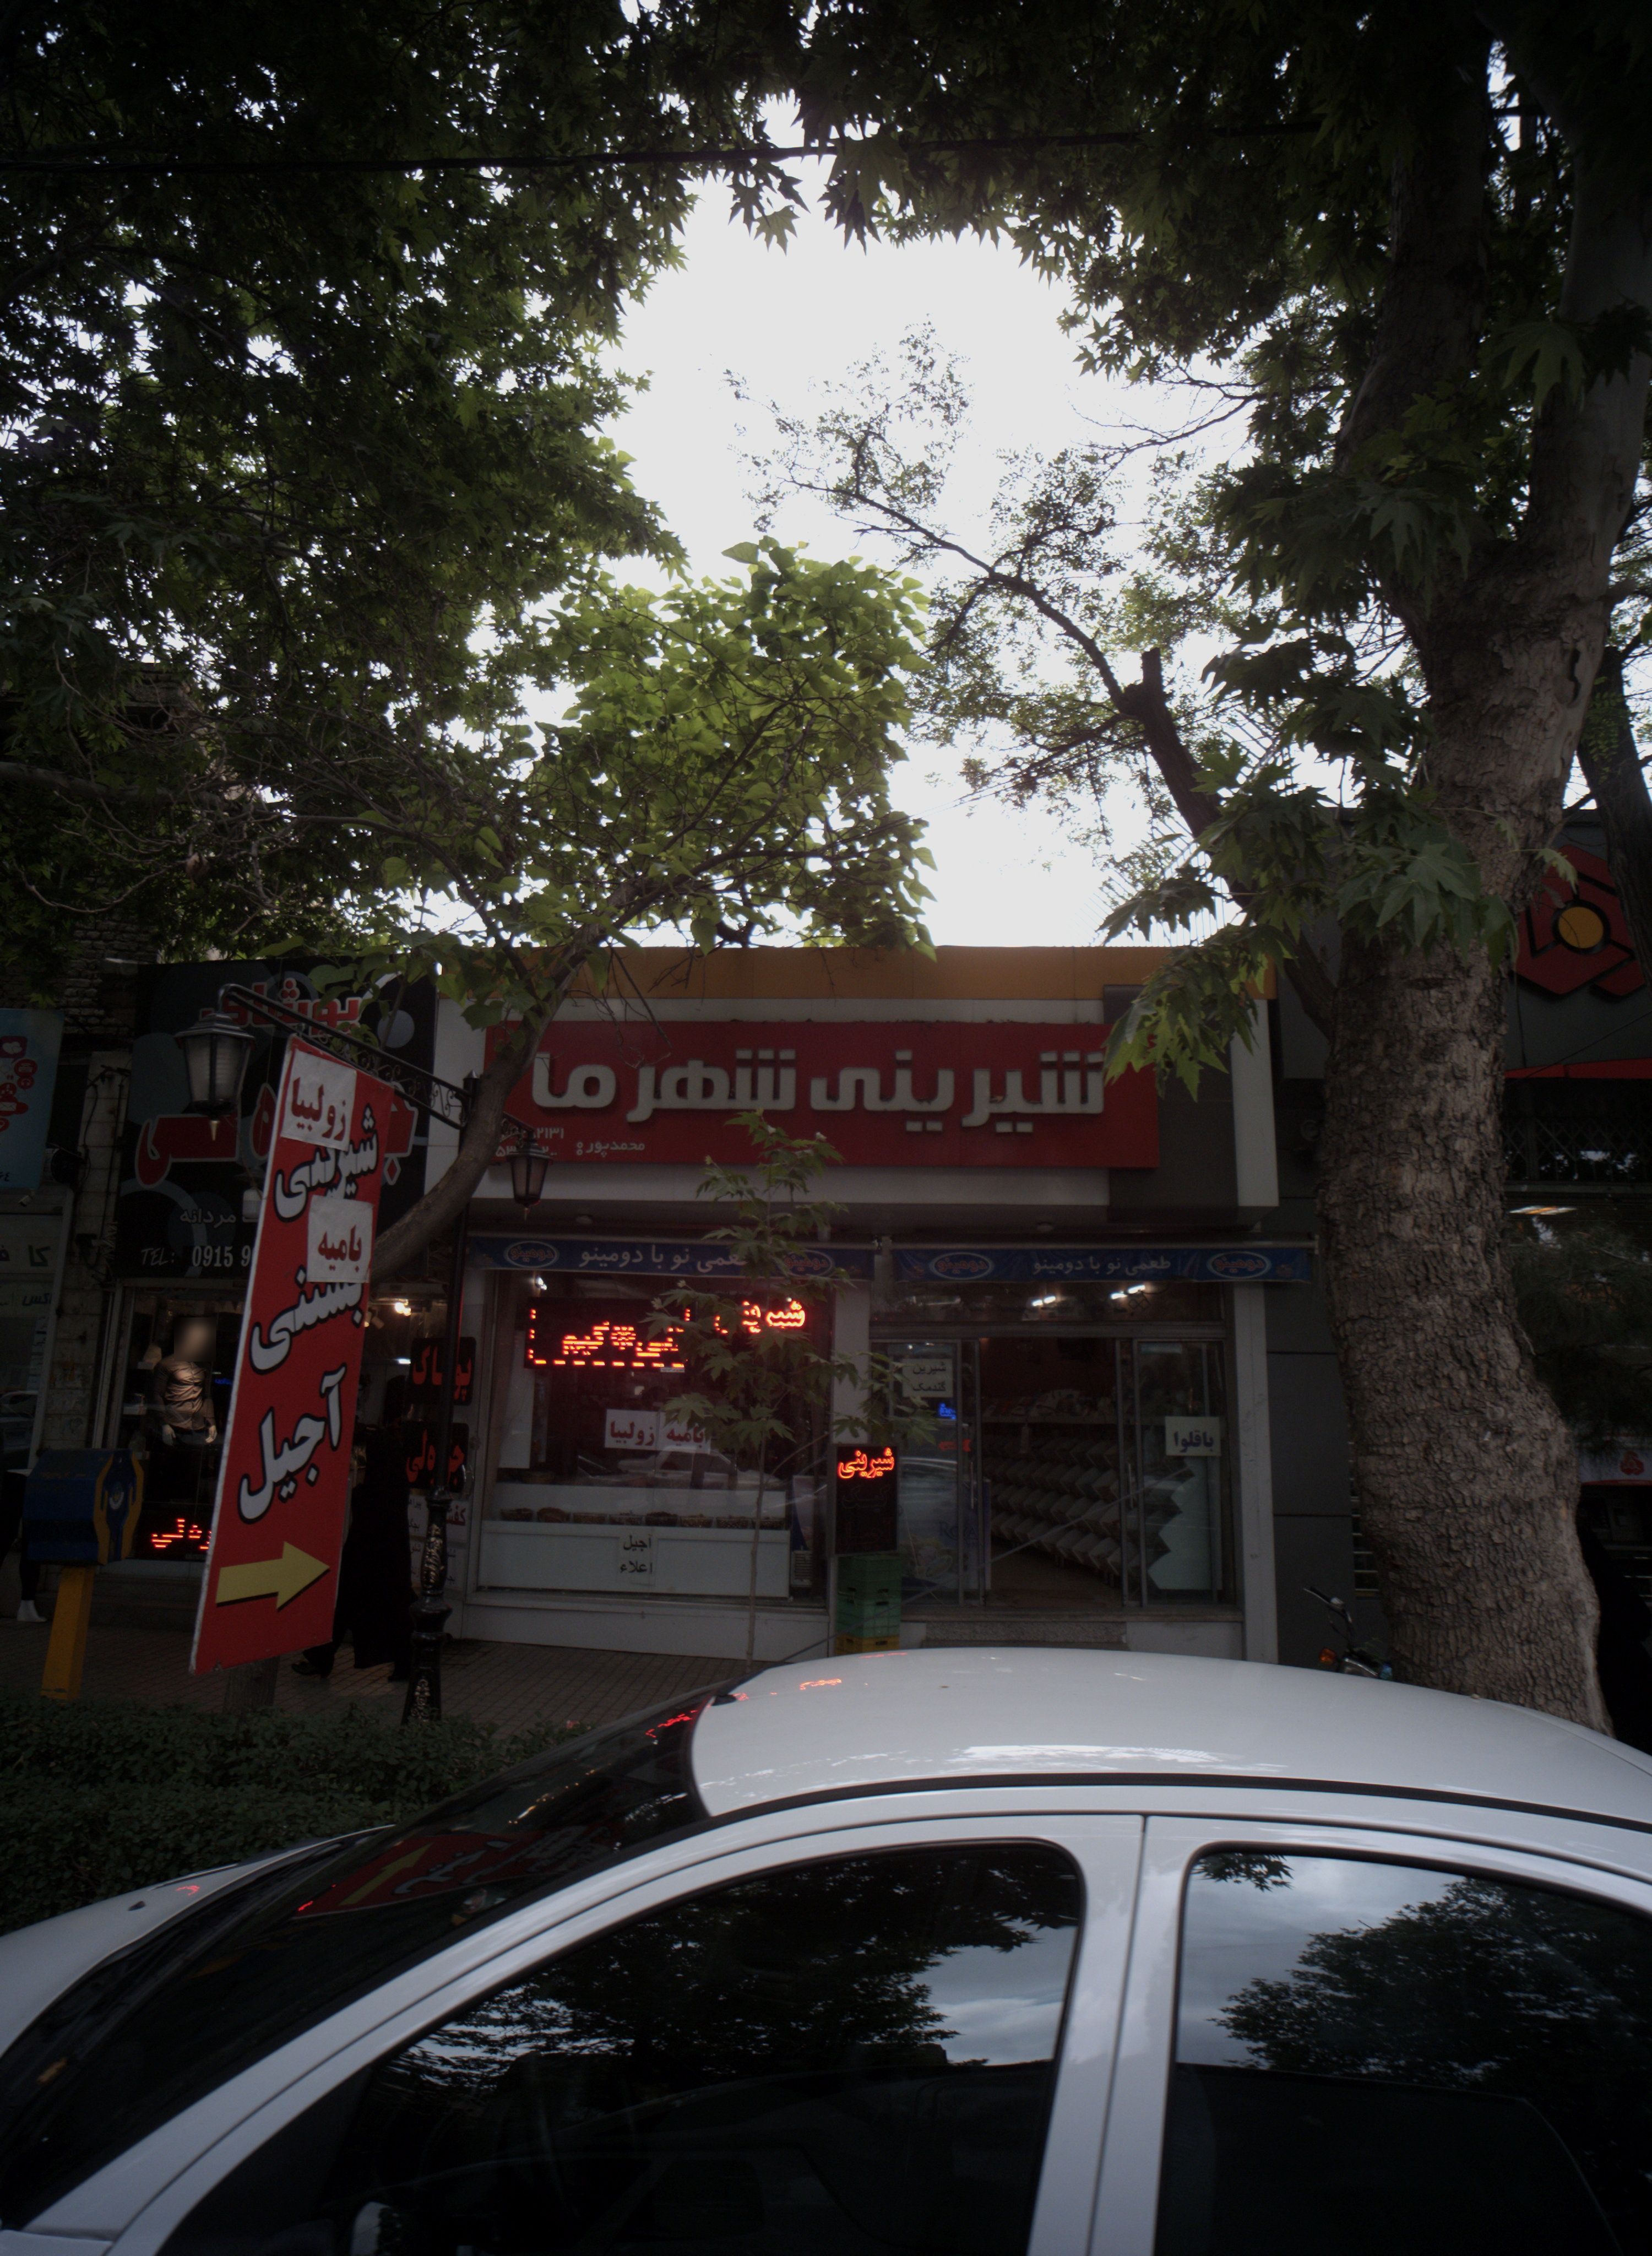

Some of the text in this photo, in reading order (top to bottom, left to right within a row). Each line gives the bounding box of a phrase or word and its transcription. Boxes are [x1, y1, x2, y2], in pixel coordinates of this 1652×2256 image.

[531, 1049, 1104, 1134] شیرینی شهر ما
[291, 1077, 346, 1141] زولبیا
[179, 1208, 237, 1229] مردانه
[141, 1247, 175, 1266] TEL:
[192, 1245, 234, 1268] 0915
[318, 1225, 362, 1273] بامیه
[578, 1244, 748, 1273] عمی نو با دومینو
[1032, 1255, 1172, 1276] طعمی نو با دومینو
[412, 1344, 472, 1401] پواک
[238, 1363, 346, 1523] آجیل
[610, 1420, 655, 1446] زولبیا
[666, 1424, 704, 1449] بامیه
[1173, 1429, 1214, 1453] باقلوا
[836, 1446, 896, 1480] شیرینی
[622, 1533, 653, 1552] آجیل
